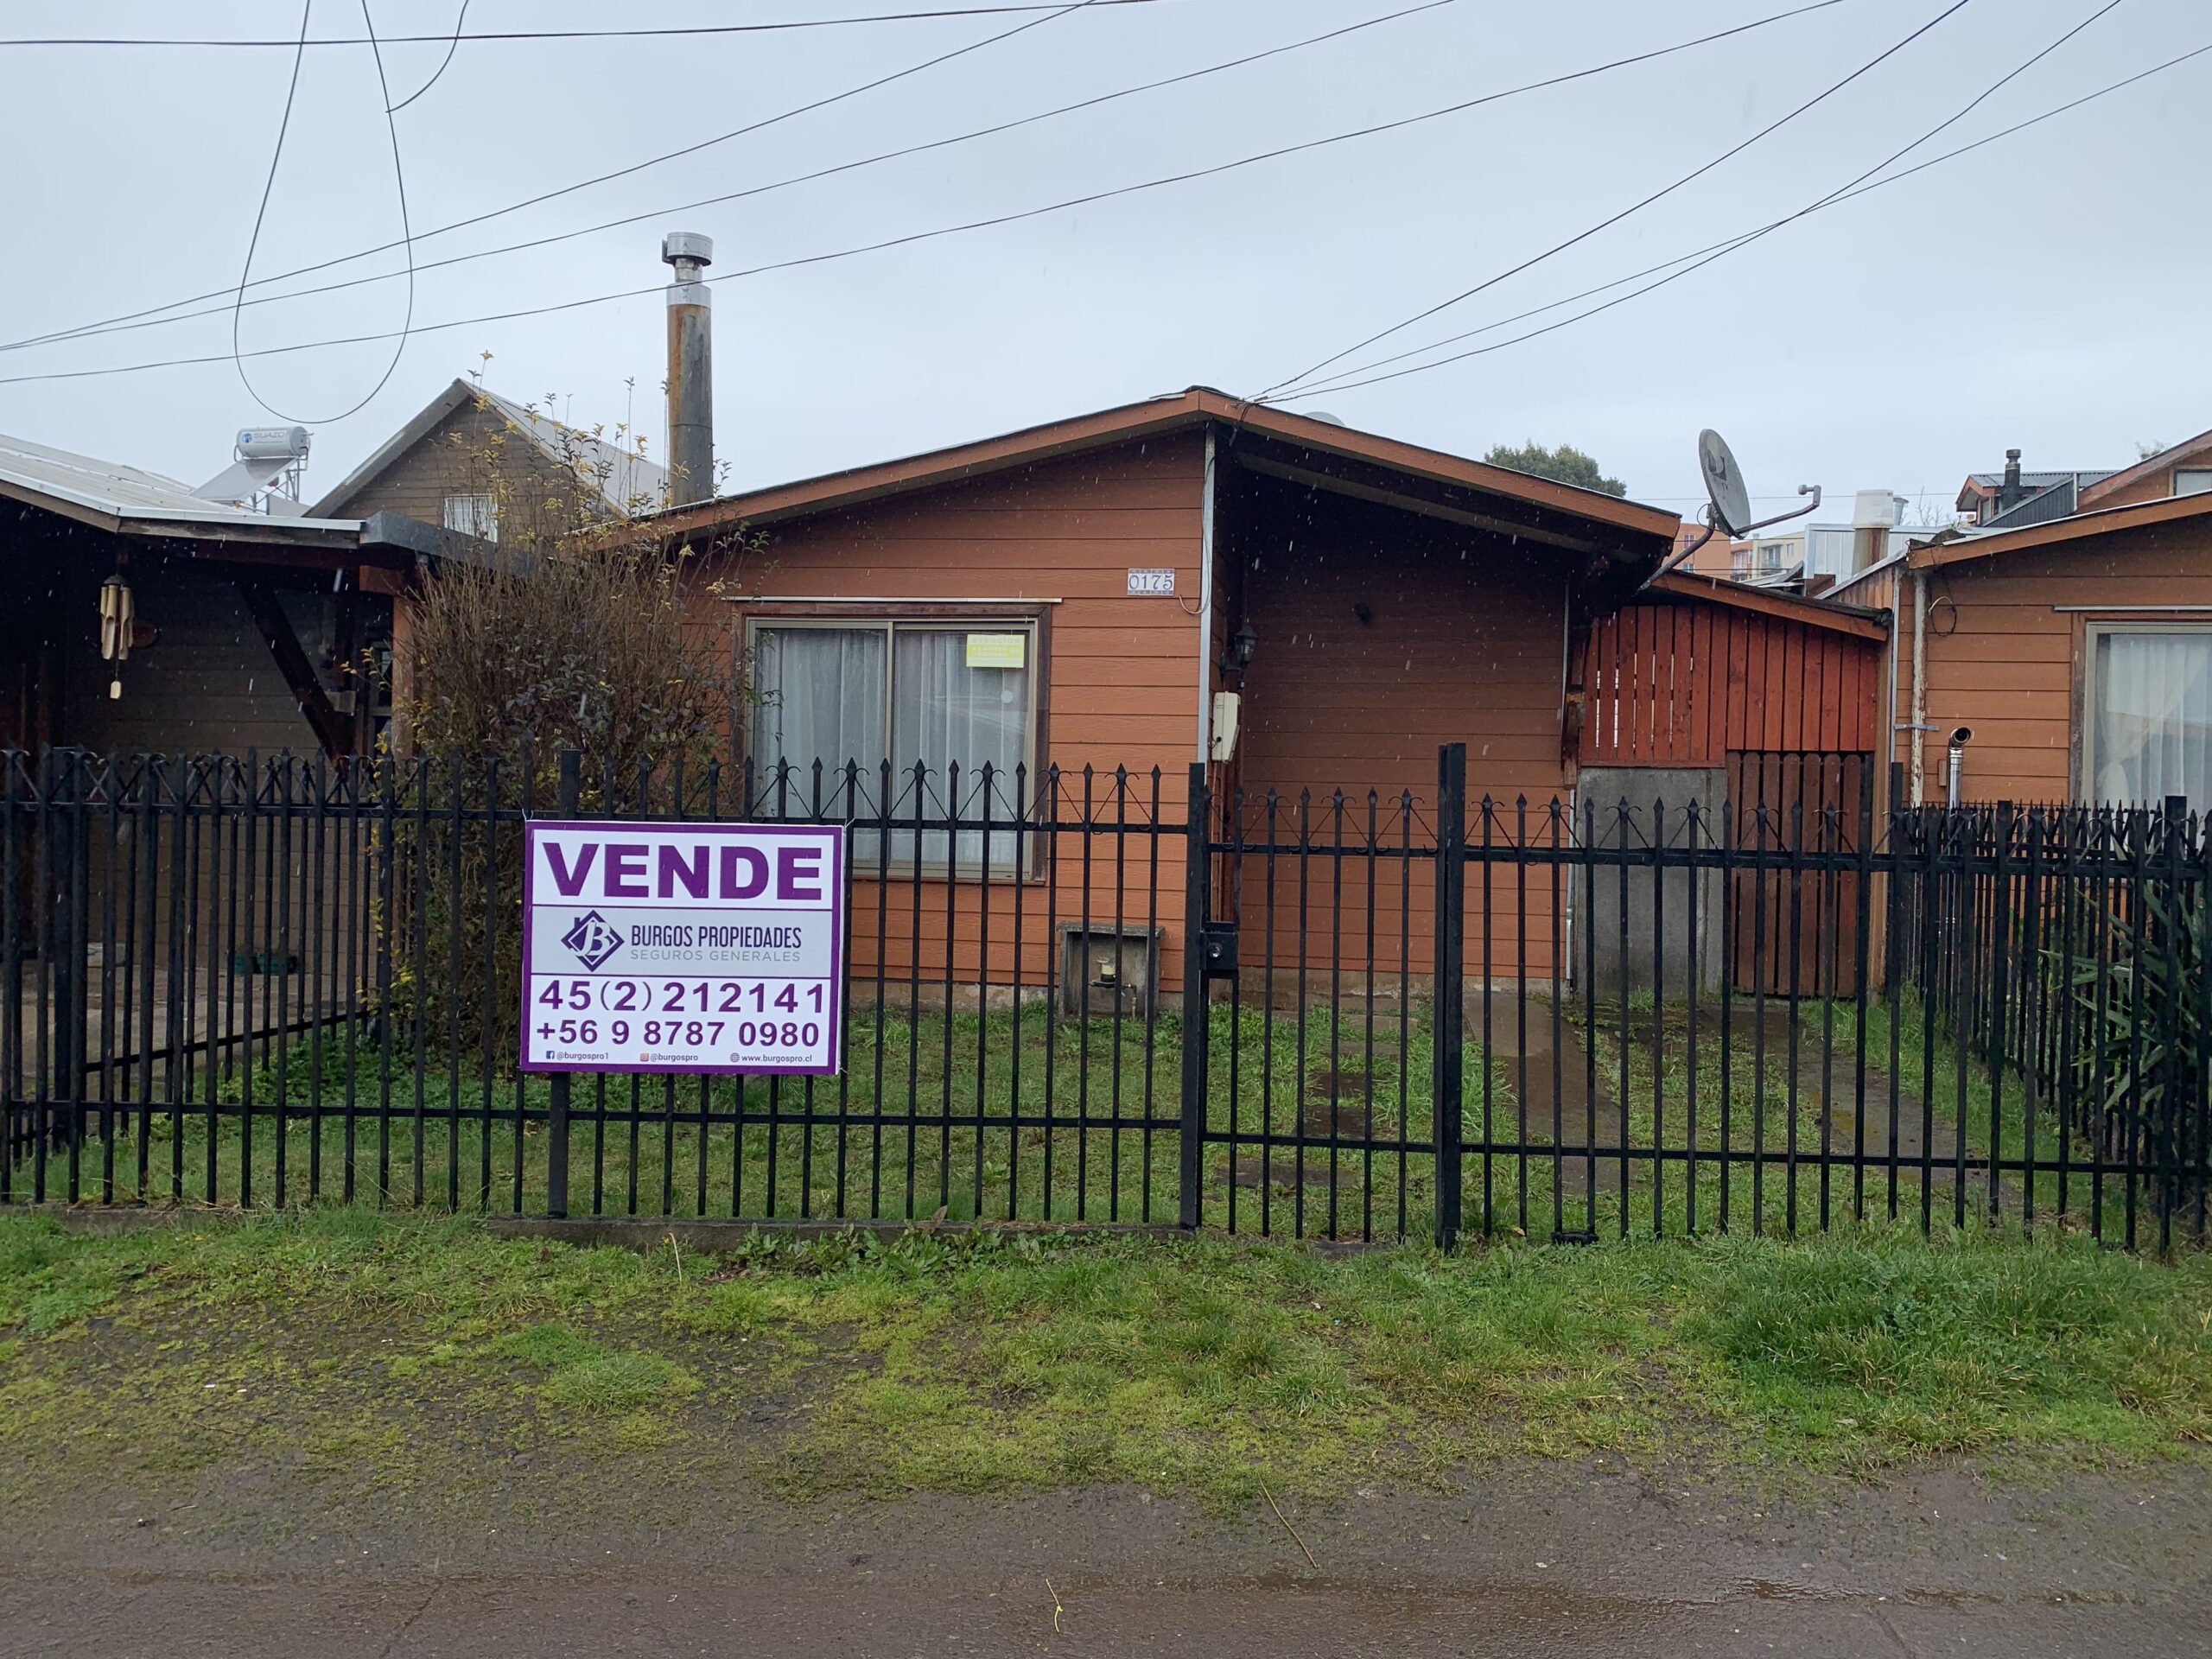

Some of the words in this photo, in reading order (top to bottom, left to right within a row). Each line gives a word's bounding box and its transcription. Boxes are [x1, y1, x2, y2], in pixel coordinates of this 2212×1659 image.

[1128, 575, 1173, 589] 0175
[542, 842, 823, 900] VENDE
[631, 925, 693, 948] BURGOS
[698, 926, 802, 949] PROPIEDADES
[631, 950, 702, 961] SEGUROS
[709, 950, 800, 962] GENERALES
[537, 1020, 598, 1045] +56
[611, 1020, 630, 1045] 9
[644, 1020, 725, 1046] 8787
[739, 1022, 819, 1047] 0980
[556, 1052, 608, 1061] @burgospro1
[650, 1053, 698, 1062] @burgospro
[741, 1053, 812, 1063] www.burgospro.cl
